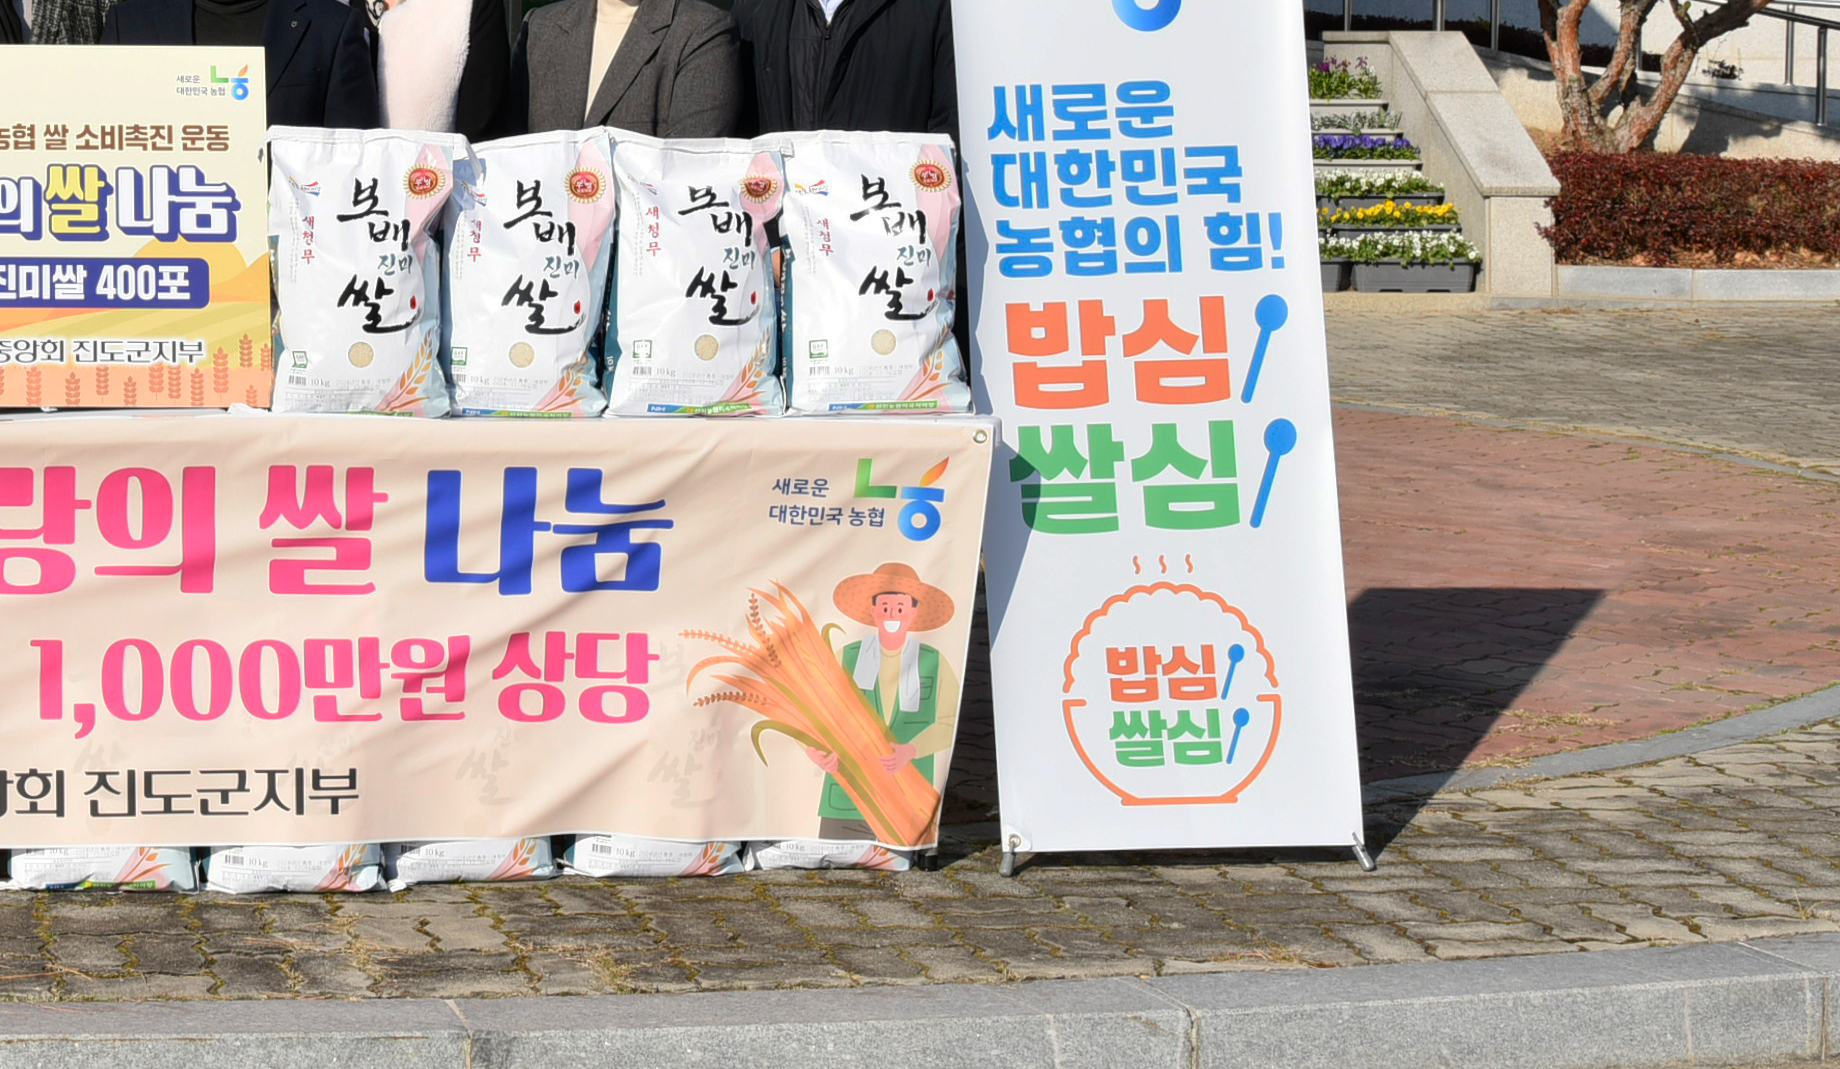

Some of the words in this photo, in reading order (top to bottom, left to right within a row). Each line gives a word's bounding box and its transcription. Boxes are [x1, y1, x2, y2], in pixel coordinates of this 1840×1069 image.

[177, 75, 200, 83] 새로운
[177, 87, 207, 96] 대한민국
[211, 87, 225, 96] 농협
[988, 81, 1174, 141] 새로운
[44, 125, 69, 150] 쌀
[76, 125, 173, 151] 소비촉진
[182, 125, 229, 151] 운동
[44, 164, 110, 240] 쌀
[115, 165, 239, 241] 나눔
[992, 146, 1242, 208] 대한민국
[646, 205, 661, 256] 새청무
[817, 218, 833, 256] 새청무
[896, 245, 931, 267] 진미
[996, 215, 1182, 277] 농협의
[1204, 212, 1284, 271] 힘!
[96, 265, 190, 300] 400포
[377, 253, 413, 275] 진미
[543, 255, 580, 280] 진미
[722, 246, 756, 270] 진미
[336, 273, 420, 334] 쌀
[501, 273, 587, 335] 쌀
[685, 266, 759, 326] 쌀
[858, 265, 937, 320] 쌀
[74, 340, 204, 364] 진도군지부
[1006, 296, 1231, 409] 밥심
[772, 478, 829, 497] 새로운
[1009, 420, 1240, 534] 쌀심
[260, 465, 388, 595] 쌀
[425, 467, 674, 595] 나눔
[769, 505, 843, 525] 대한민국
[848, 507, 884, 527] 농협
[30, 635, 470, 739] 1,000만원
[492, 631, 659, 723] 상당
[1106, 645, 1217, 702] 밥심
[1110, 709, 1222, 767] 쌀심
[84, 768, 359, 817] 진도군지부
